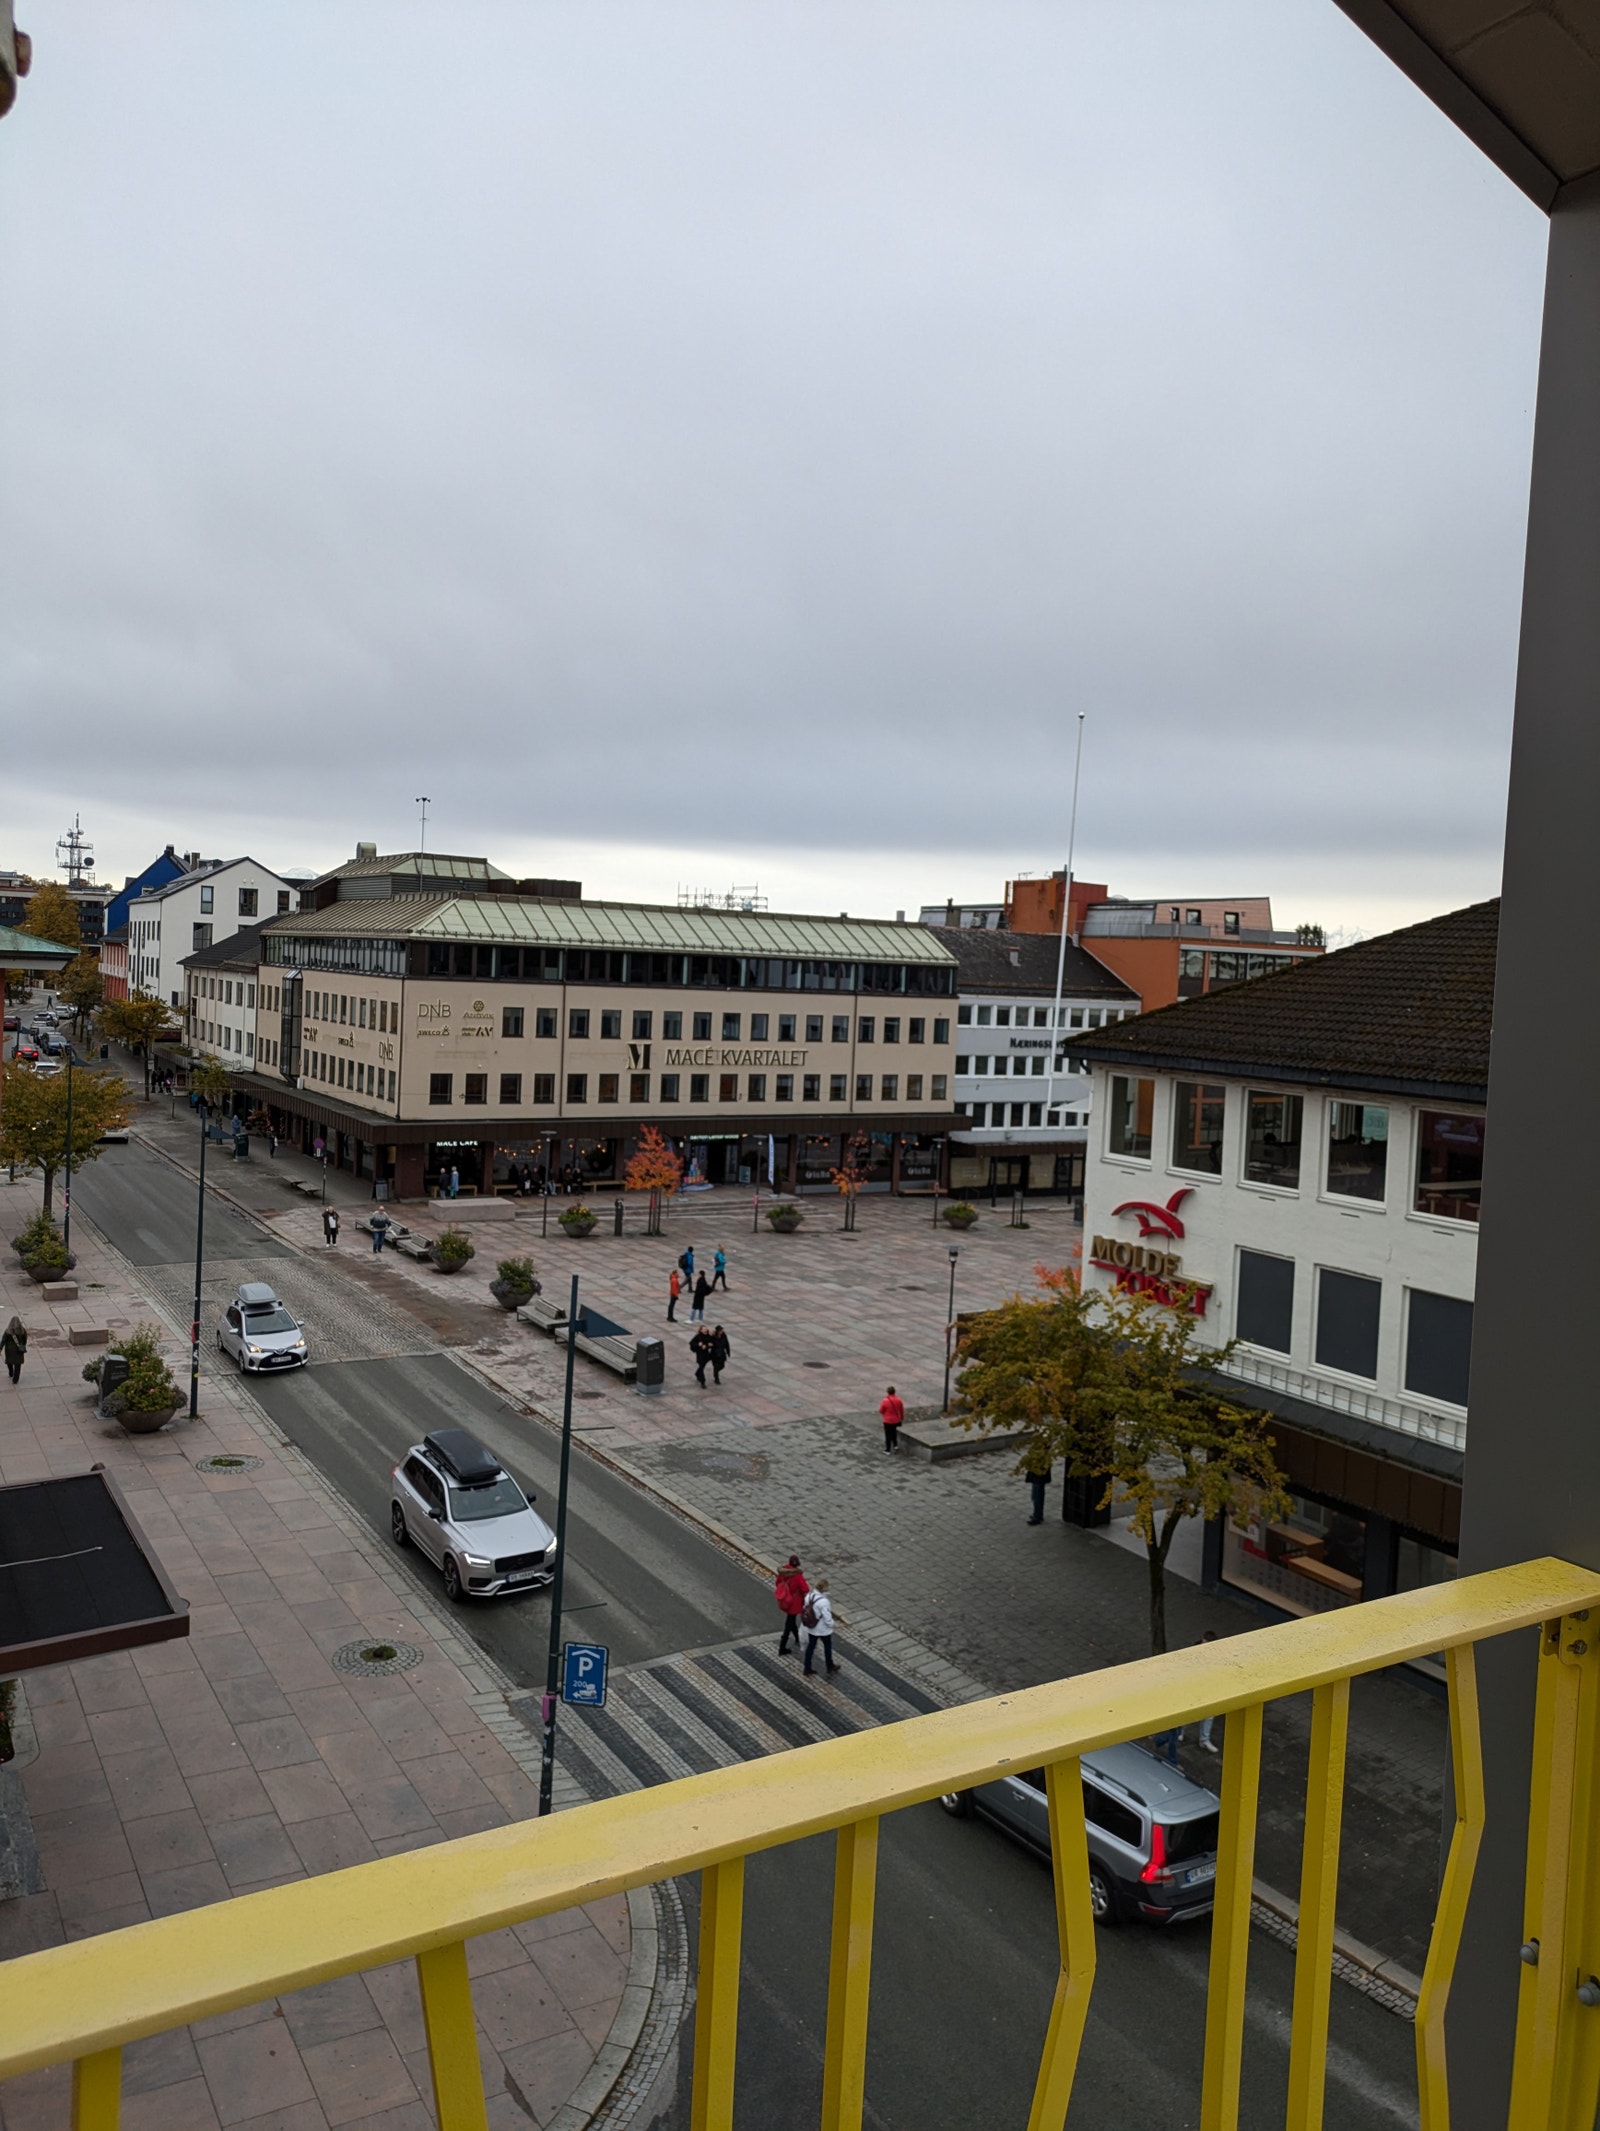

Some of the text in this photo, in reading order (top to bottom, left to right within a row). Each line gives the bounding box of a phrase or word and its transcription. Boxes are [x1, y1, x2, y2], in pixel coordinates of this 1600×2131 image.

[418, 1000, 451, 1022] DNB
[379, 1037, 394, 1065] DNB
[666, 1046, 714, 1066] MACÉ
[721, 1050, 809, 1066] KVARTALET
[1090, 1235, 1182, 1279] MOLDE
[579, 1656, 594, 1677] P
